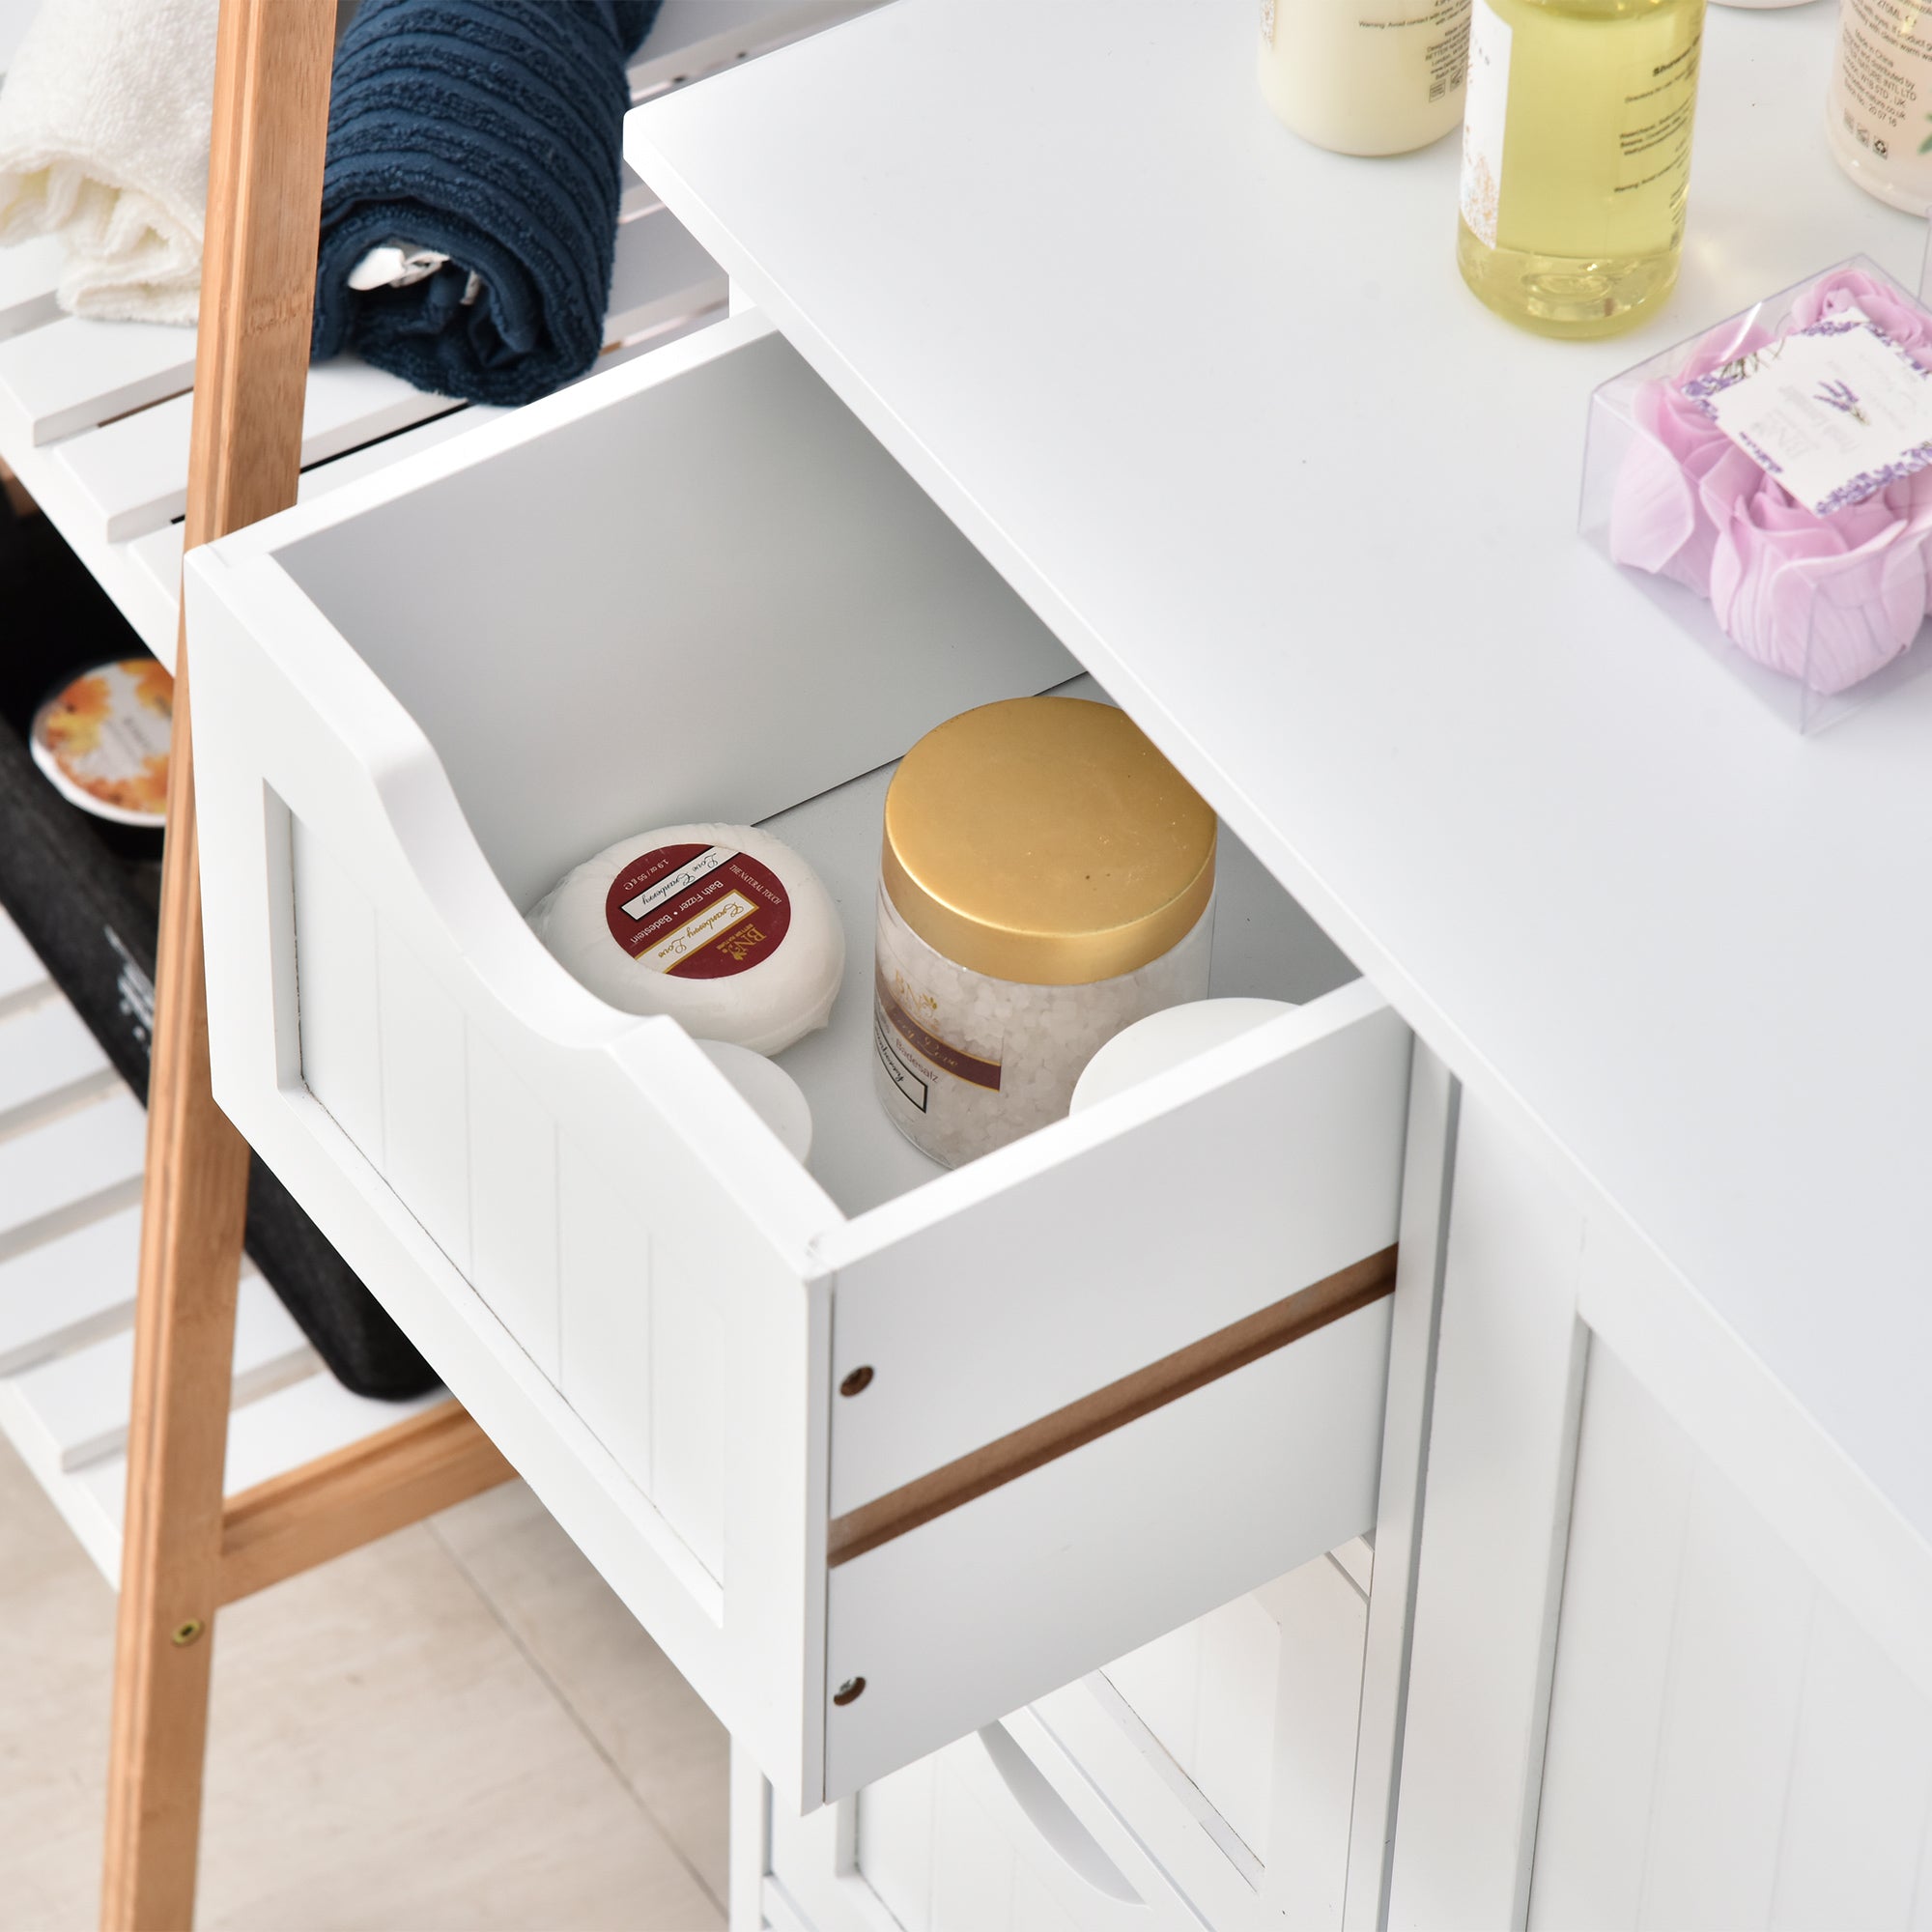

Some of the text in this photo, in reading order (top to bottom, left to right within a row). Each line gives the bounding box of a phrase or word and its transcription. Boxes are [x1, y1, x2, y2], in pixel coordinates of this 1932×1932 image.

[1899, 44, 1920, 58] warm
[1901, 88, 1918, 101] LTD
[641, 853, 719, 905] Love Cranberry
[657, 858, 669, 868] 1.9
[728, 865, 782, 905] THE NATURAL TOUCH
[630, 880, 724, 944] Bath Fizzer Badestein
[658, 902, 745, 958] Cranberry Love
[895, 1038, 940, 1084] Badesalz
